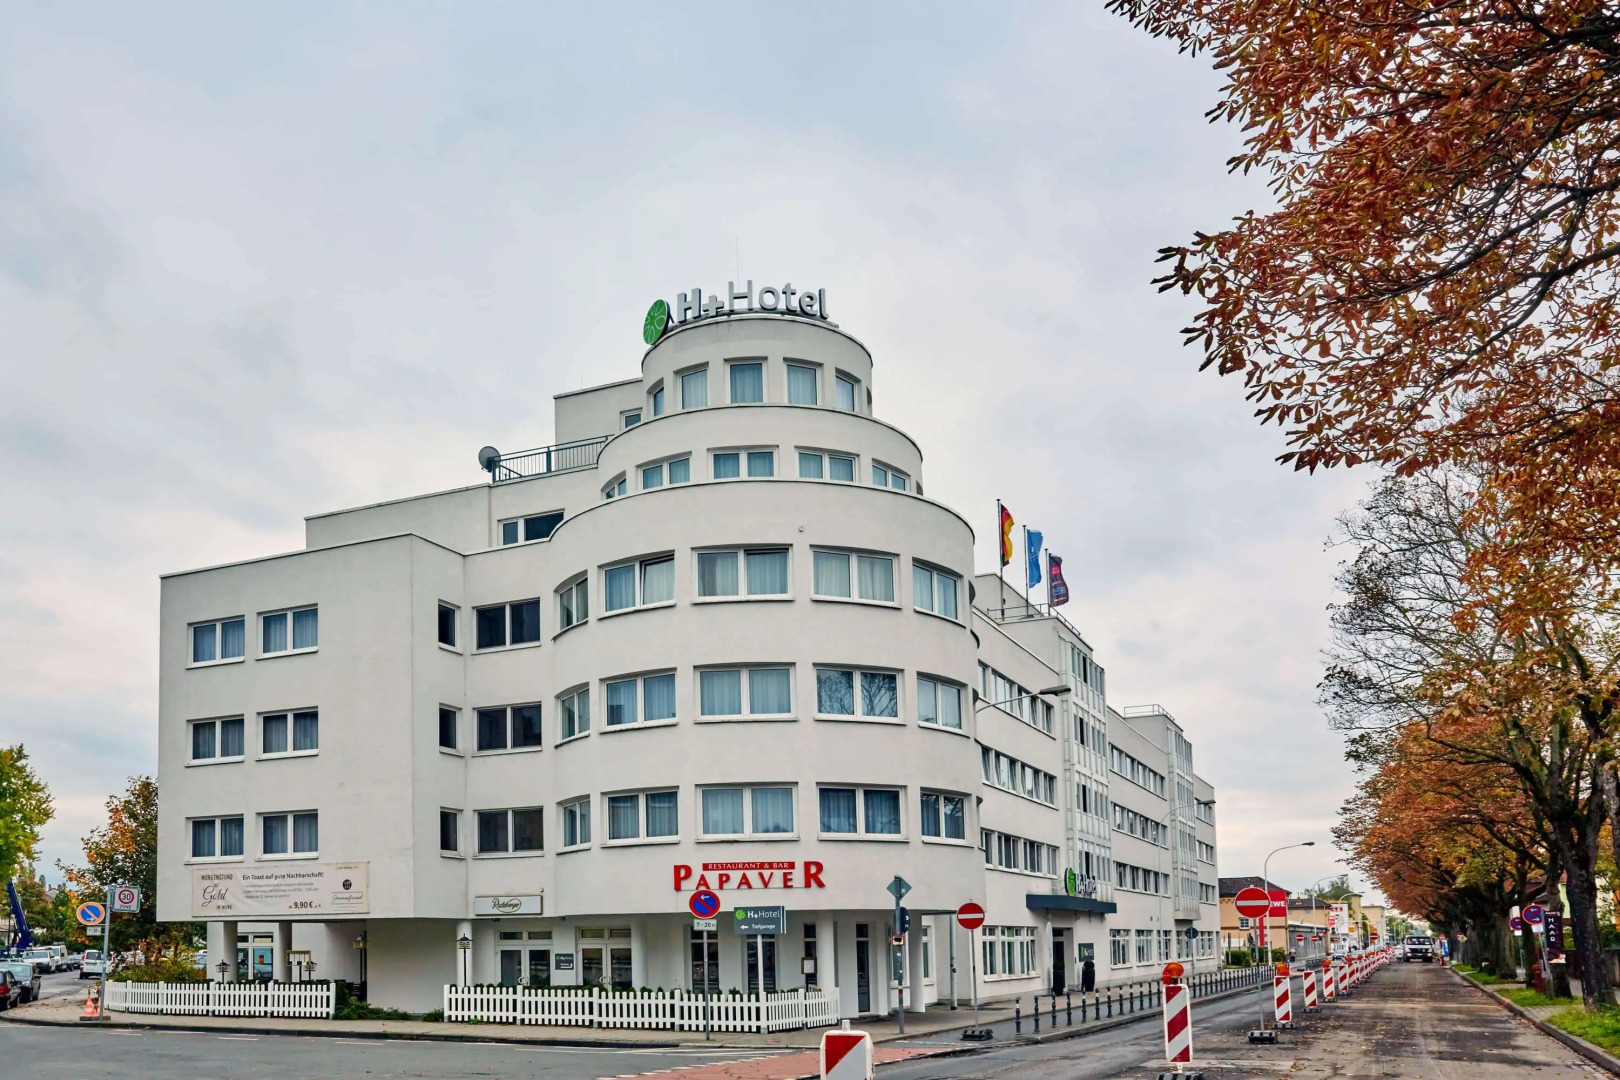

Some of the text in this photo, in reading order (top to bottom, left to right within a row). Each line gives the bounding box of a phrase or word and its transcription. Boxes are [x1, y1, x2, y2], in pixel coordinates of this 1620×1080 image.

[677, 279, 829, 323] H+Hotel
[708, 862, 762, 870] RESTAURANT
[286, 871, 324, 879] Nachbarschaft!
[673, 861, 826, 891] PAPAVER
[201, 885, 228, 907] Gold
[293, 901, 308, 909] 9,90
[747, 910, 780, 919] H+Hotel
[1548, 917, 1556, 942] HAAR
